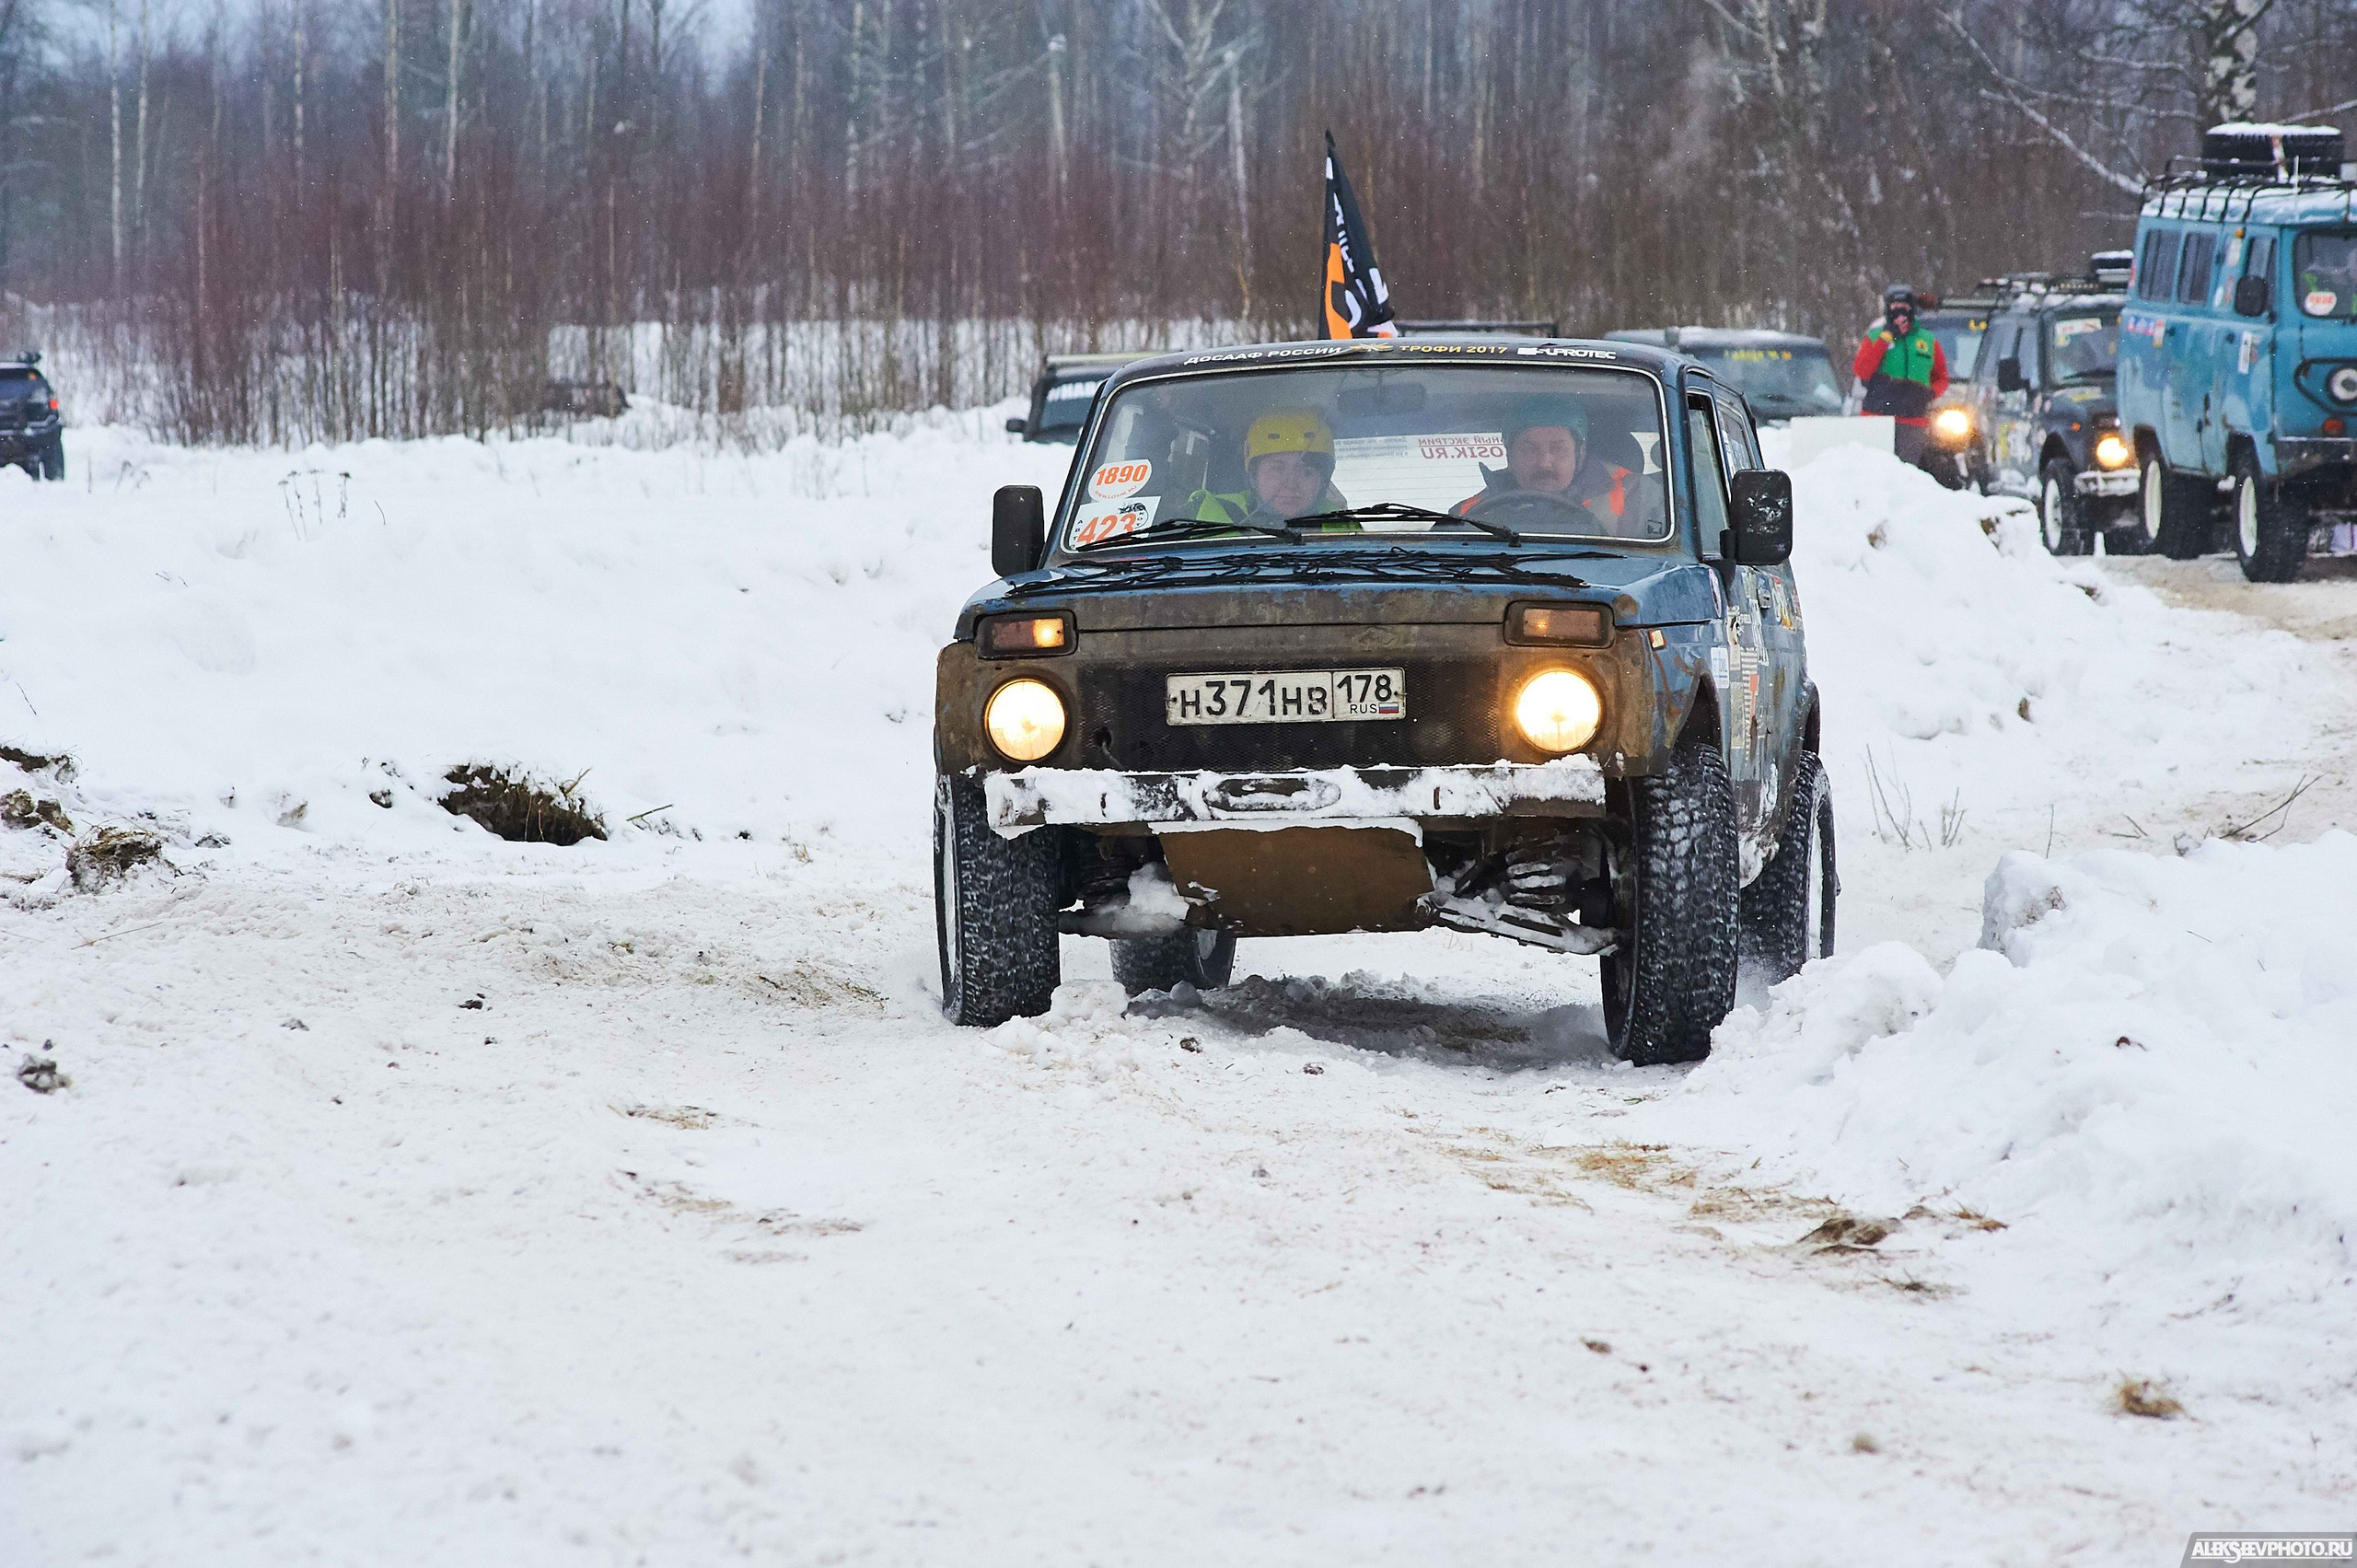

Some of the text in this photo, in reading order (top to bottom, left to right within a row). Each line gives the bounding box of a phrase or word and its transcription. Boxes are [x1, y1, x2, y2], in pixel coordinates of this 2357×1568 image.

[1183, 344, 1508, 366] ДОСААФ РОССИИ ТРОФИ 2017
[1517, 347, 1617, 360] SUPROTEC
[1096, 464, 1148, 486] 1890
[1076, 513, 1137, 544] 423
[1180, 674, 1392, 718] Н371НВ 178
[1349, 703, 1377, 714] RUS
